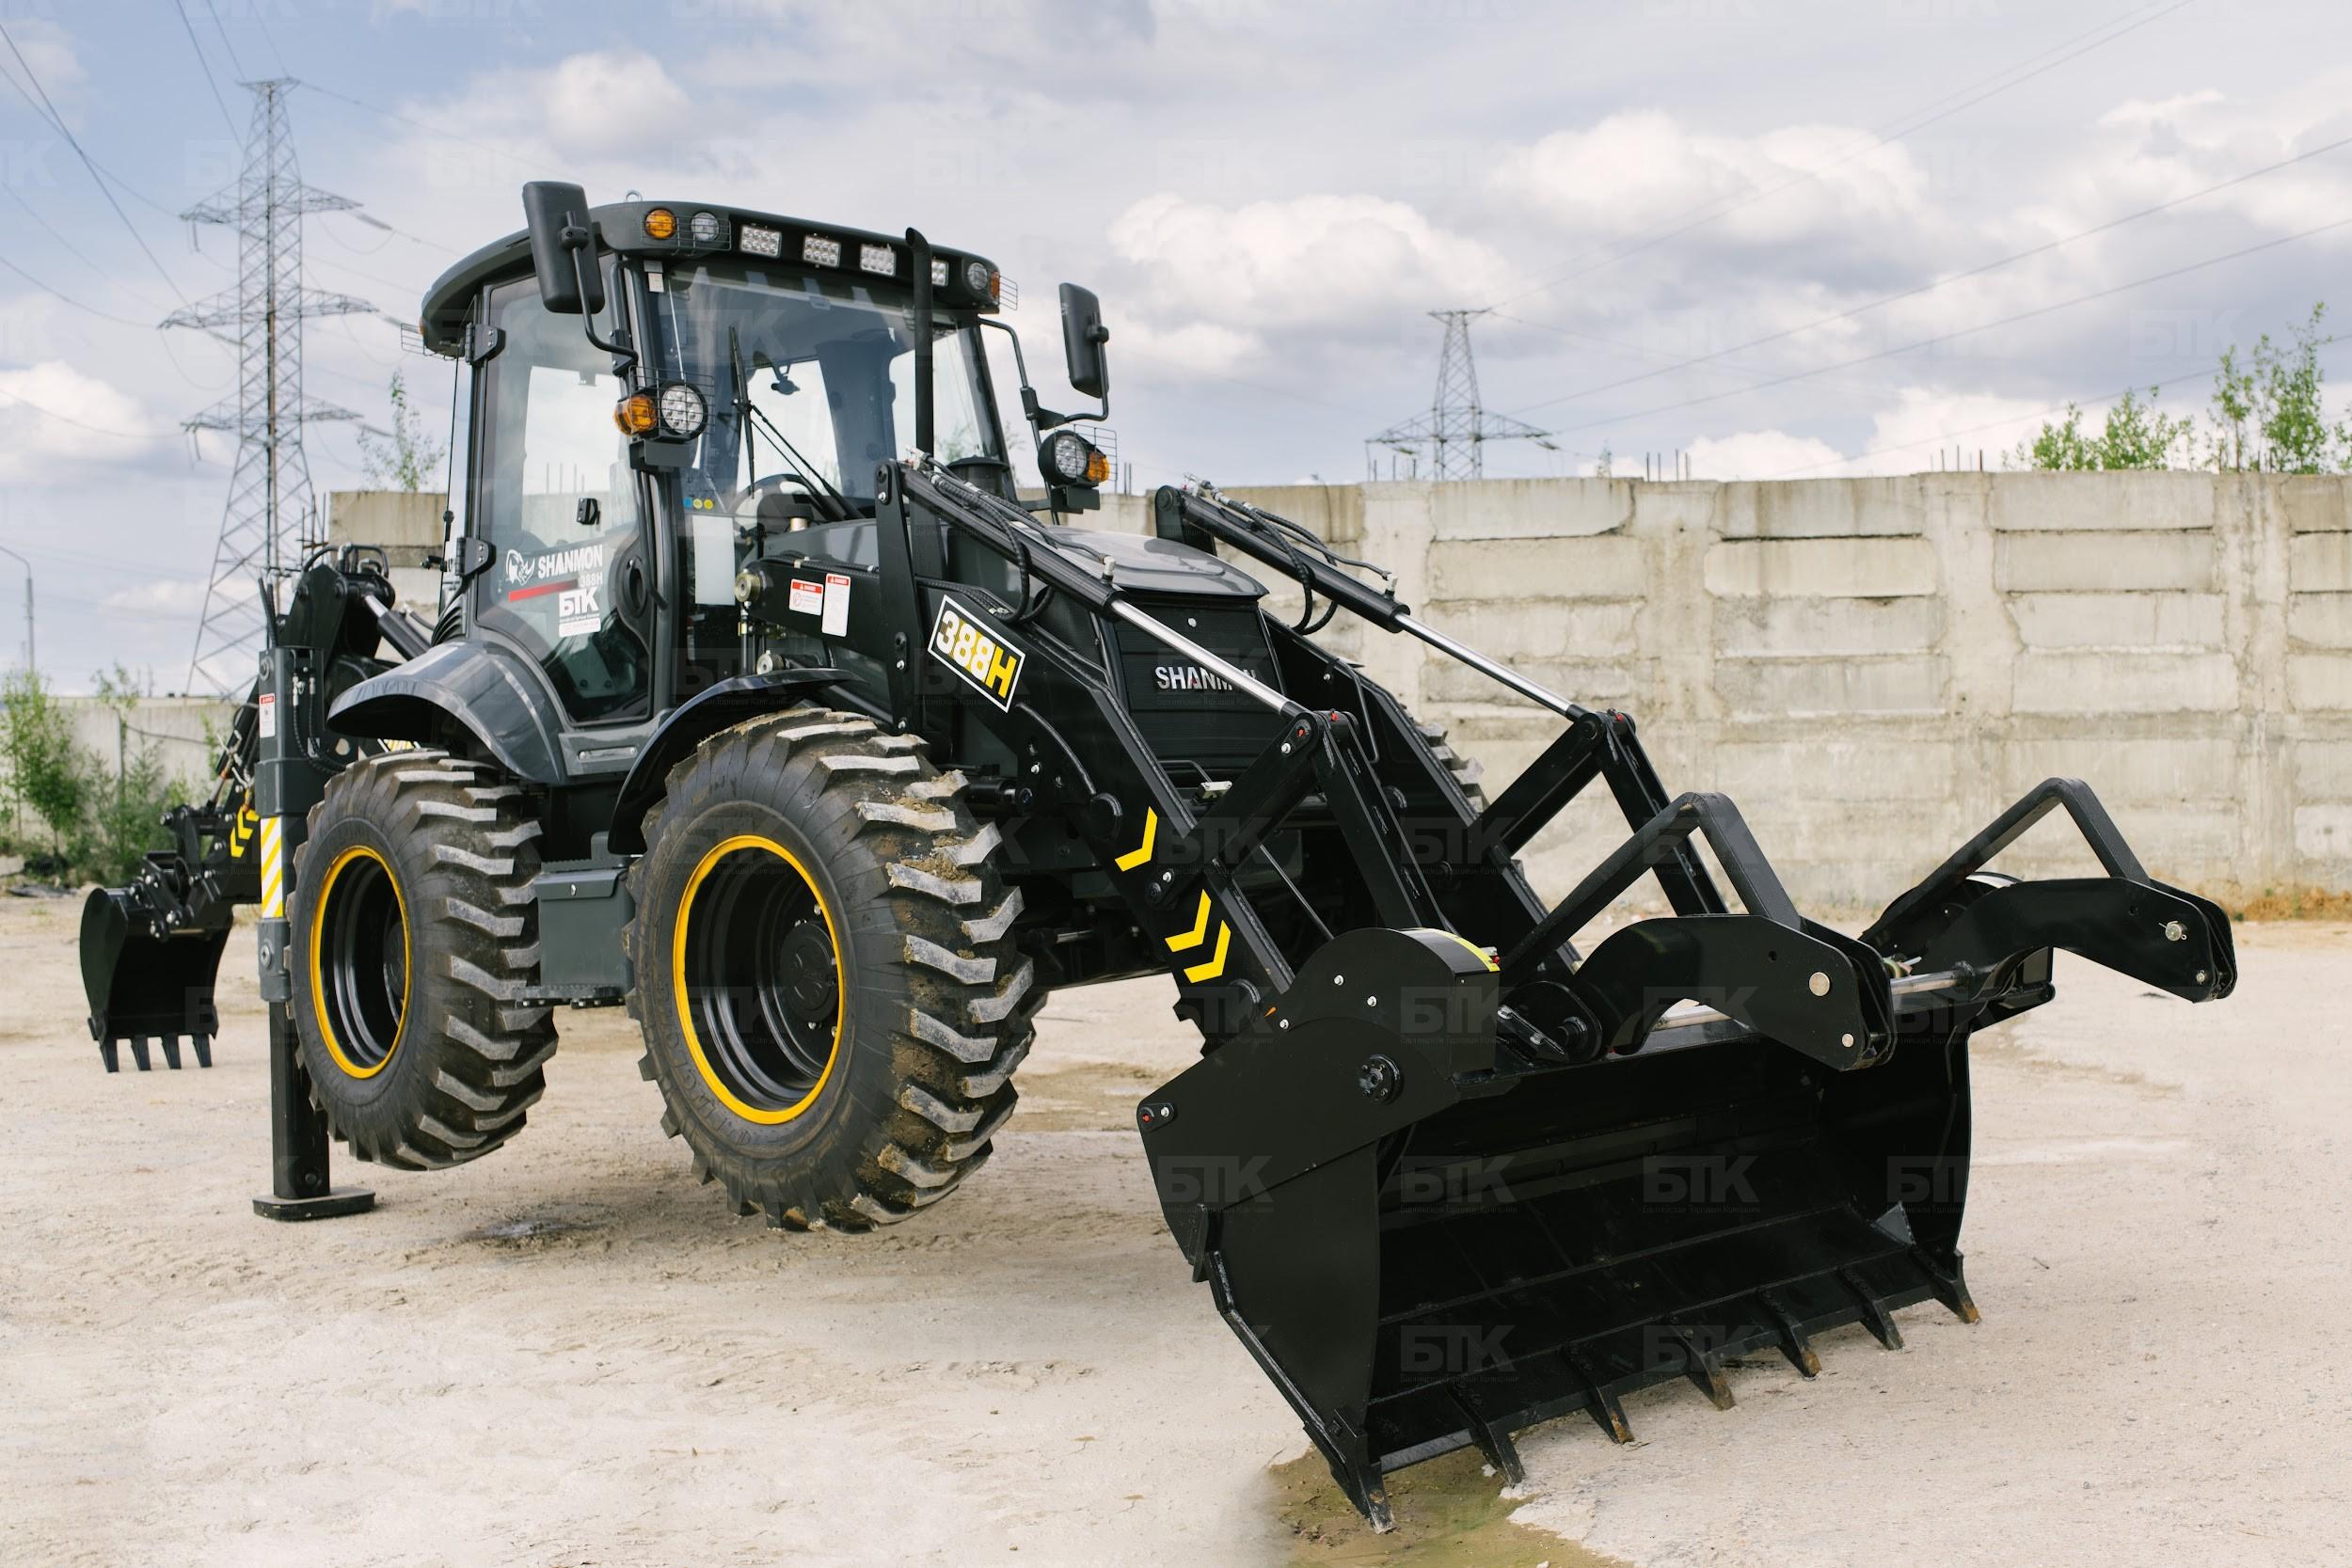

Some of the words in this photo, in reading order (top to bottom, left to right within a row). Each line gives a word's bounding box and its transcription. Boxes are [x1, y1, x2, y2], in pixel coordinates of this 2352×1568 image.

[537, 545, 603, 579] SHANMON
[558, 586, 599, 618] БТК
[936, 610, 1017, 699] 388H
